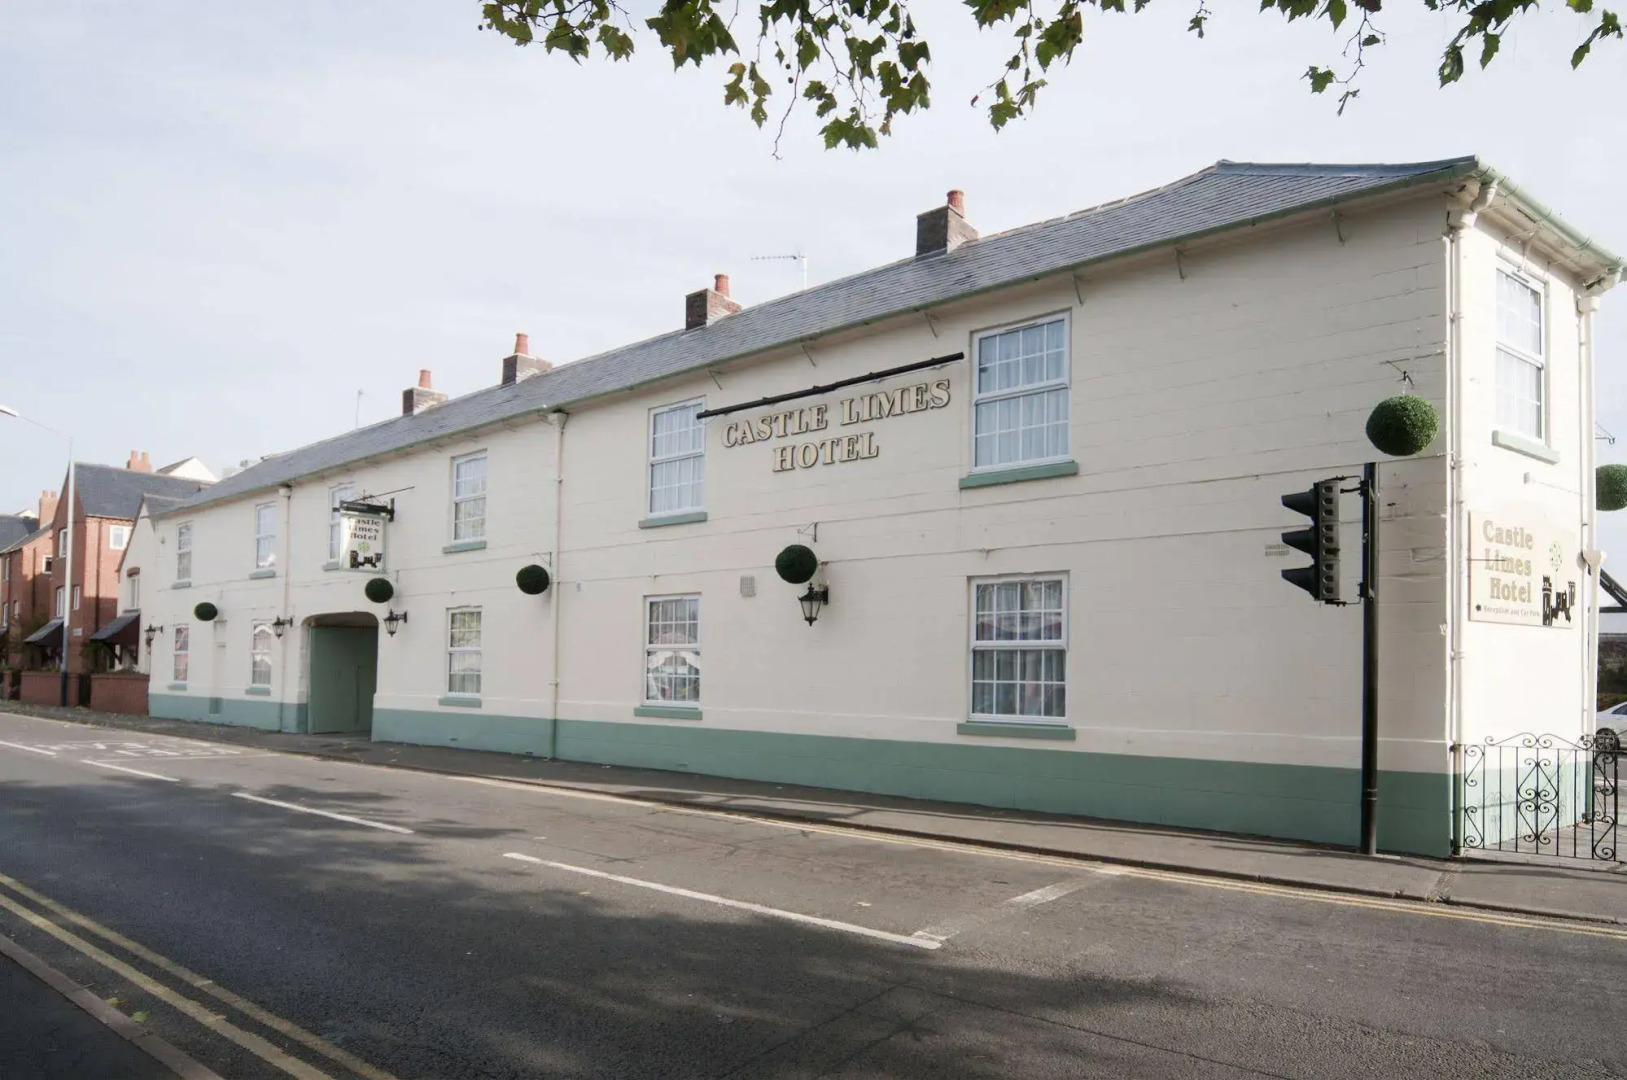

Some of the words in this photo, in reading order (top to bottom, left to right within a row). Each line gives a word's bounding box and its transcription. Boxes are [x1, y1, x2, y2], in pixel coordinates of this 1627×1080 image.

[721, 404, 828, 448] CASTLE
[840, 379, 950, 426] LIMES
[772, 432, 880, 473] HOTEL
[1482, 520, 1534, 550] Castle
[1484, 548, 1532, 576] Limes
[1490, 577, 1532, 603] Hotel
